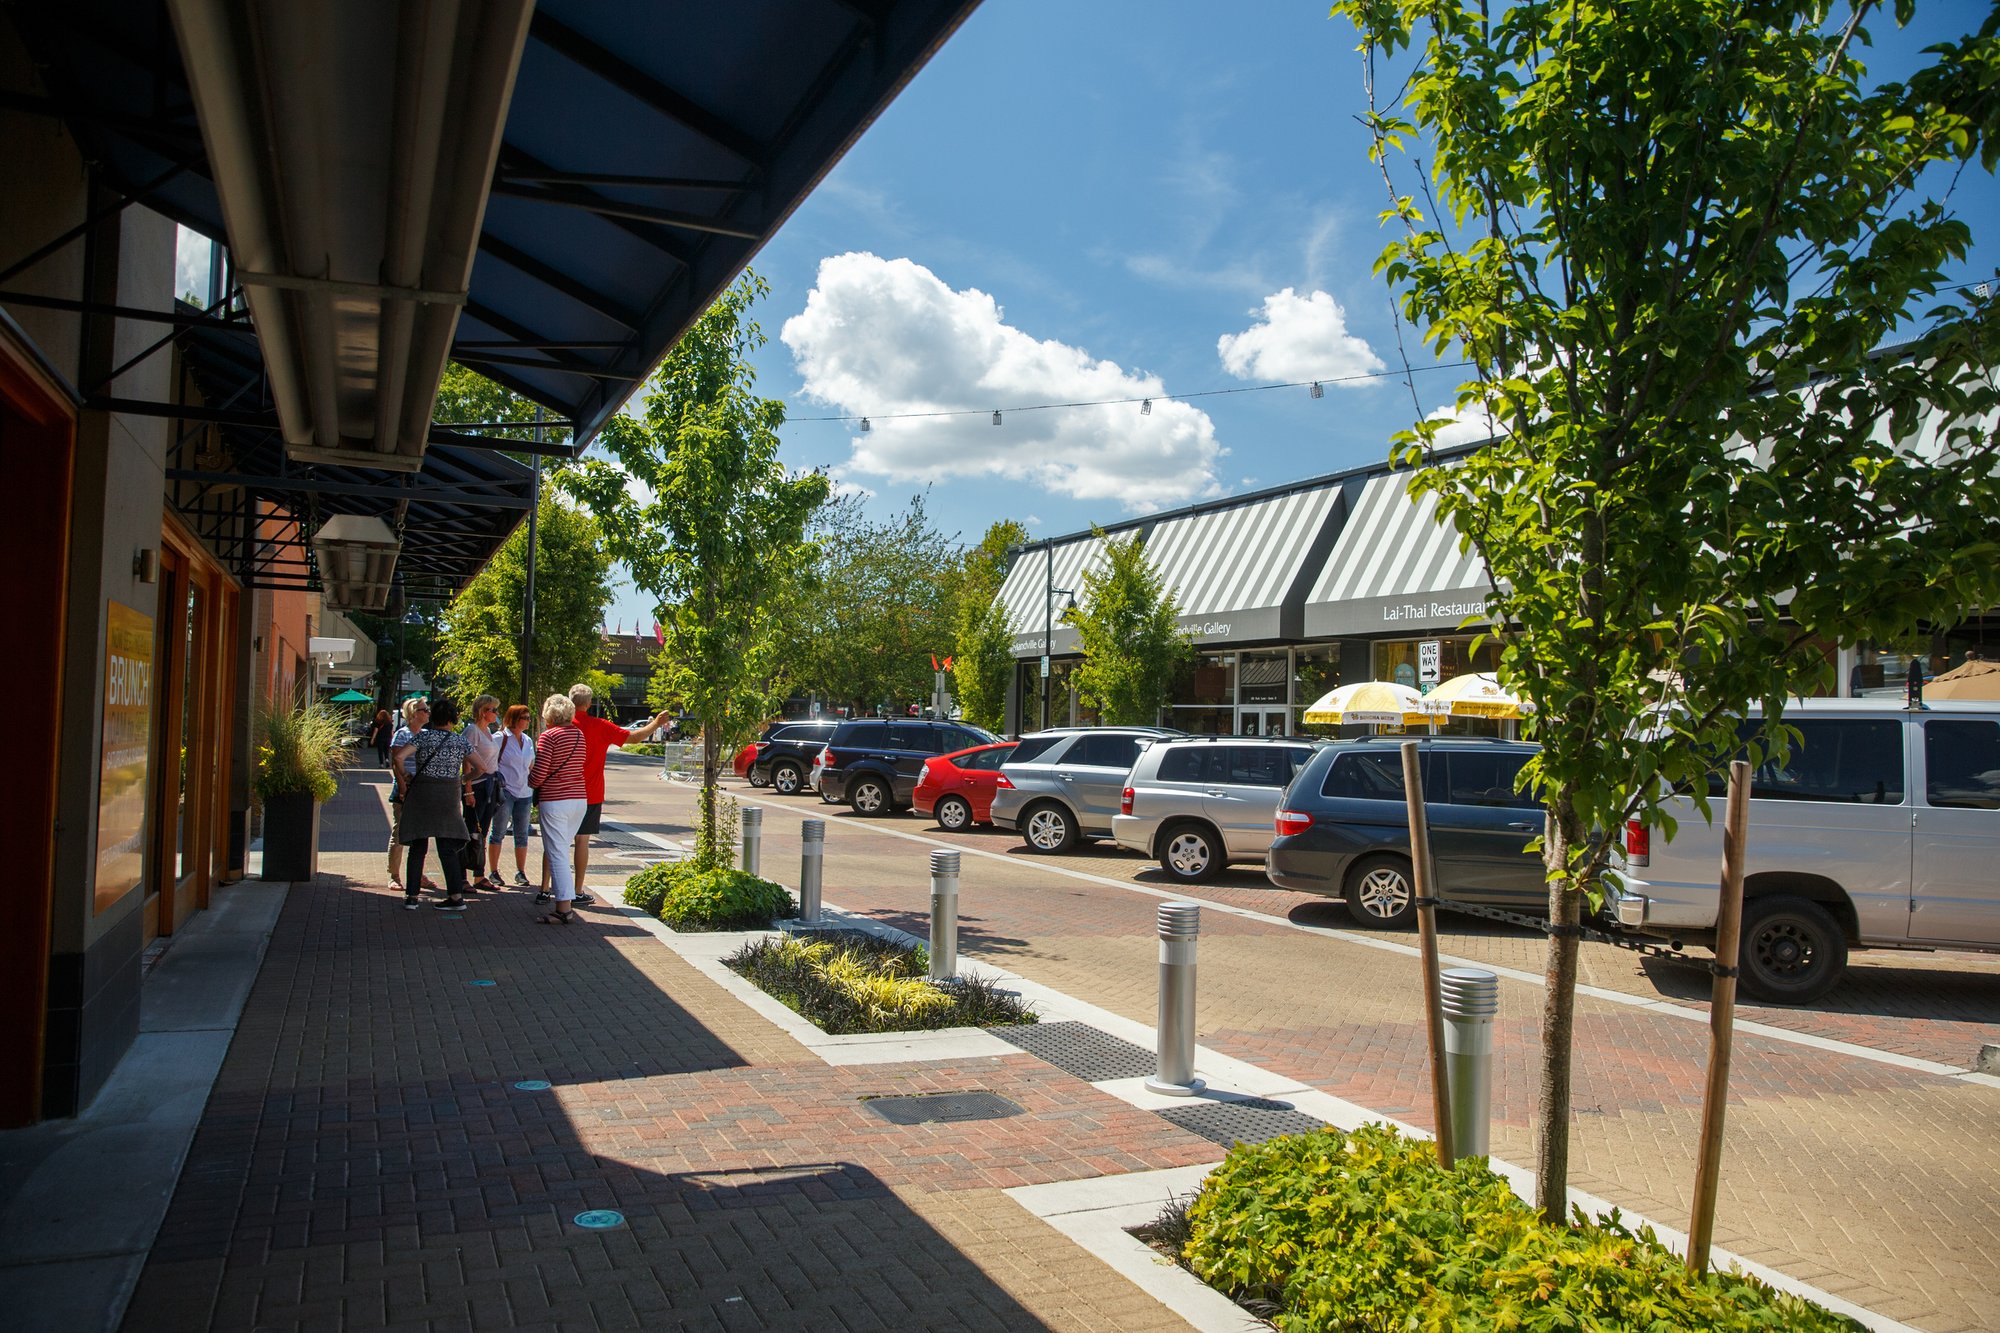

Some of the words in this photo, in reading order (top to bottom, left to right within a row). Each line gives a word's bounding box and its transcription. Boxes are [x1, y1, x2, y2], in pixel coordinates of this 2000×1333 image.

[1383, 604, 1427, 621] Lai-Thai
[1172, 623, 1202, 637] andville
[1203, 621, 1231, 636] Gallery
[635, 645, 663, 655] Sothe
[1037, 638, 1056, 650] Galry
[1421, 644, 1437, 656] ONE
[1421, 656, 1437, 667] WAY
[109, 655, 149, 706] BRUNCH
